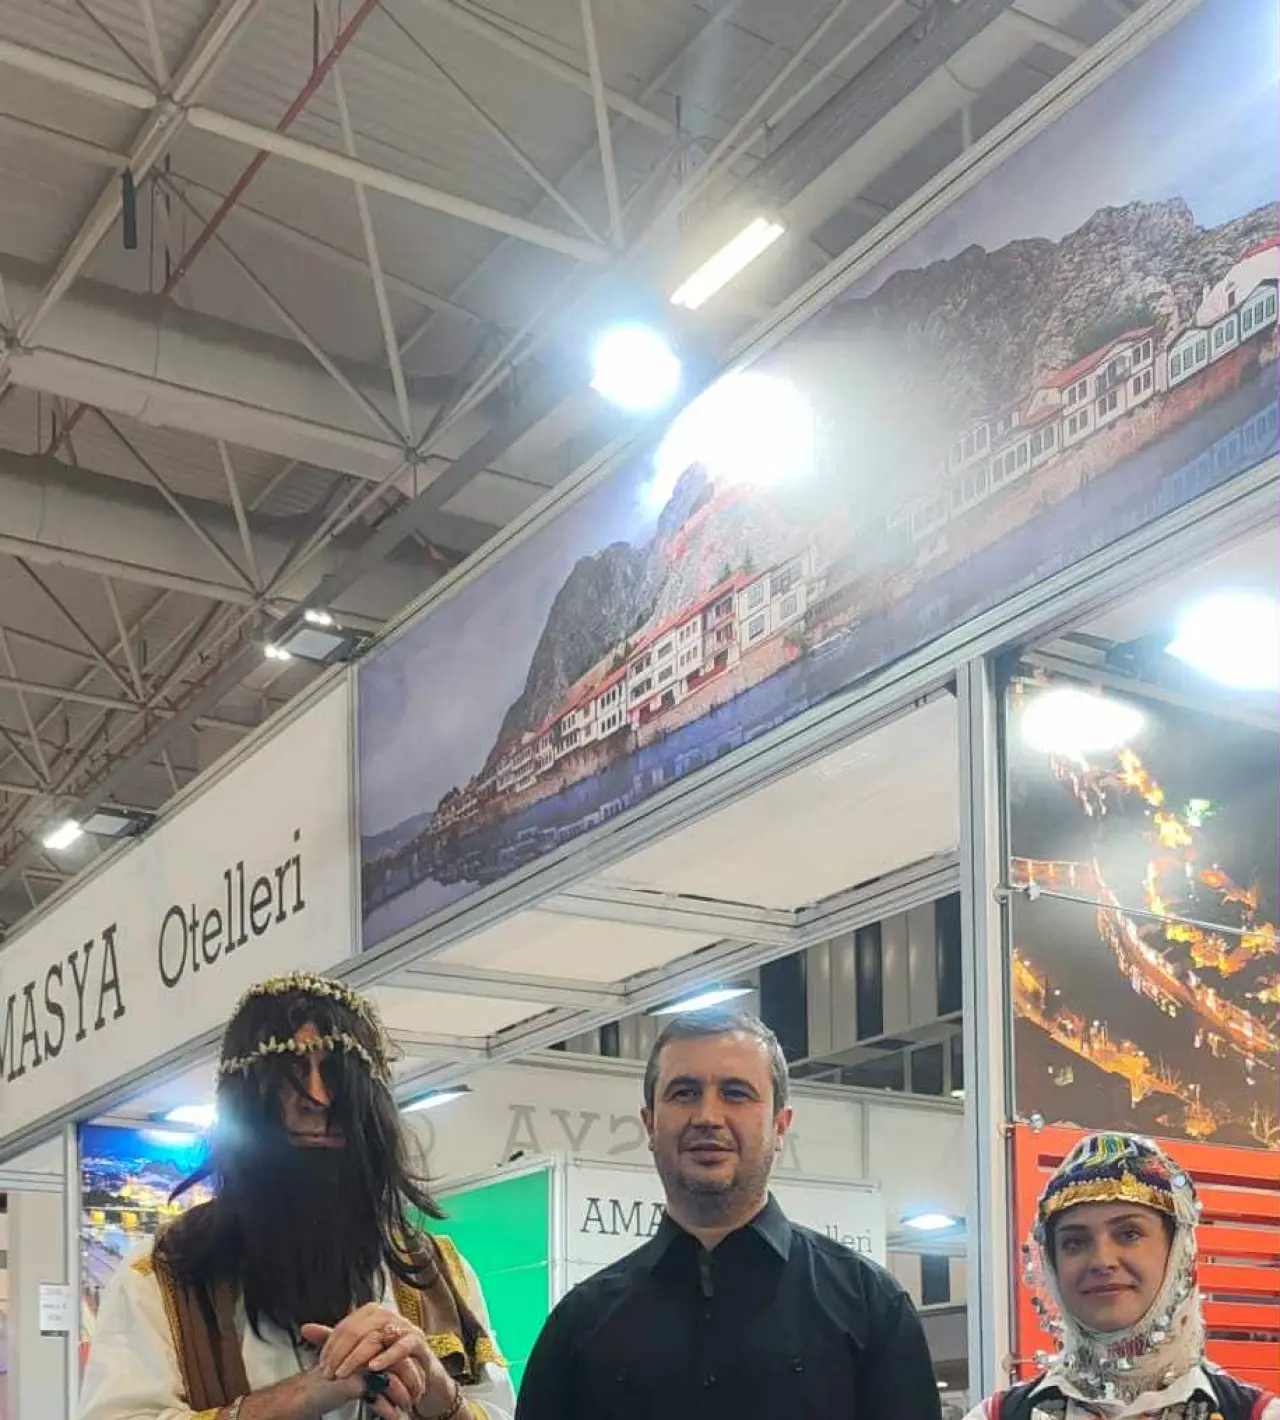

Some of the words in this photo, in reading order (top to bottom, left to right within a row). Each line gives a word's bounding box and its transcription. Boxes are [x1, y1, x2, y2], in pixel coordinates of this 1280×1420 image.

[158, 827, 305, 988] Otelleri
[580, 1197, 666, 1237] AMA
[825, 1224, 873, 1253] lleri
